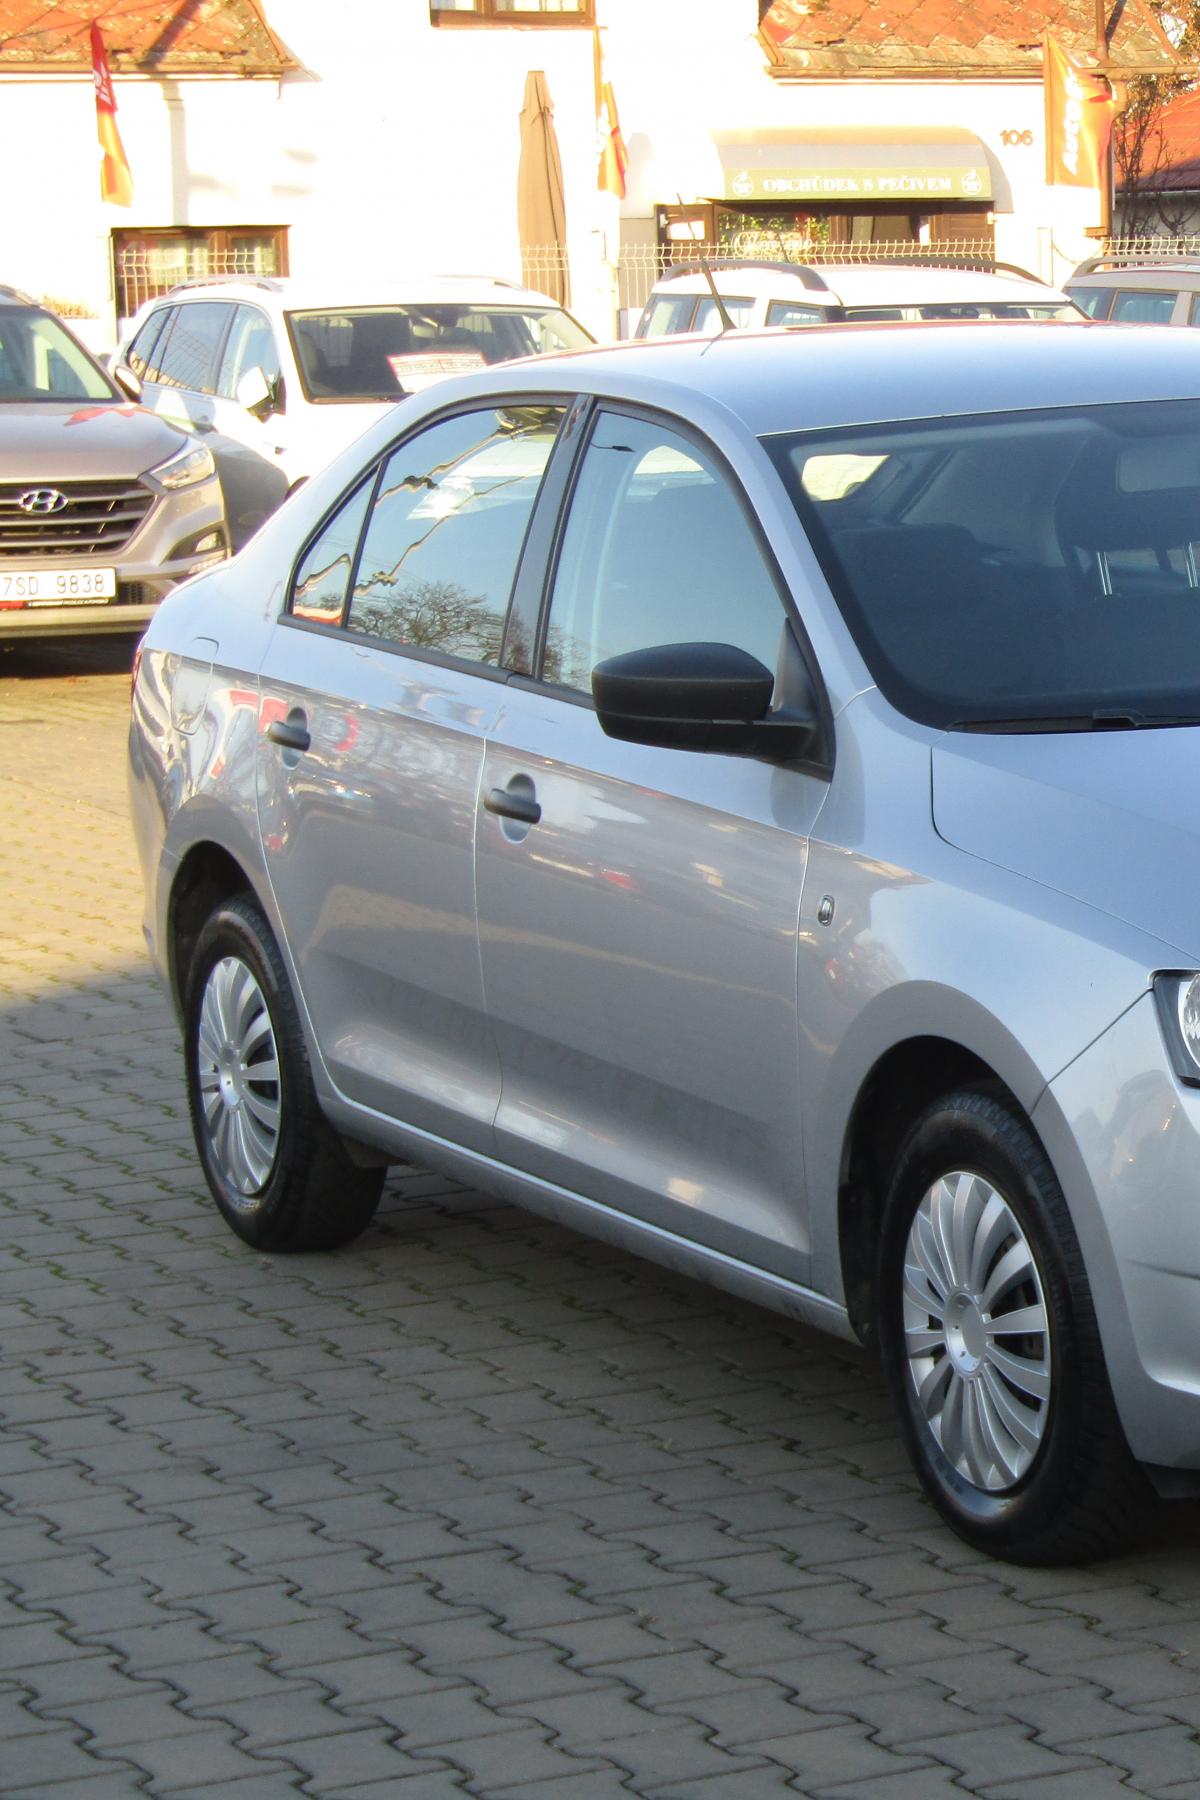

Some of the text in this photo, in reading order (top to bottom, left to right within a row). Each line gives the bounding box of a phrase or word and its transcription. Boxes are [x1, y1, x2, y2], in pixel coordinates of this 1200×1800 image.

[1000, 129, 1033, 145] 106
[763, 175, 859, 192] OBCHŮDEK
[863, 177, 873, 192] S
[877, 174, 952, 192] PEČIVEM
[3, 574, 104, 596] 7SD 9838
